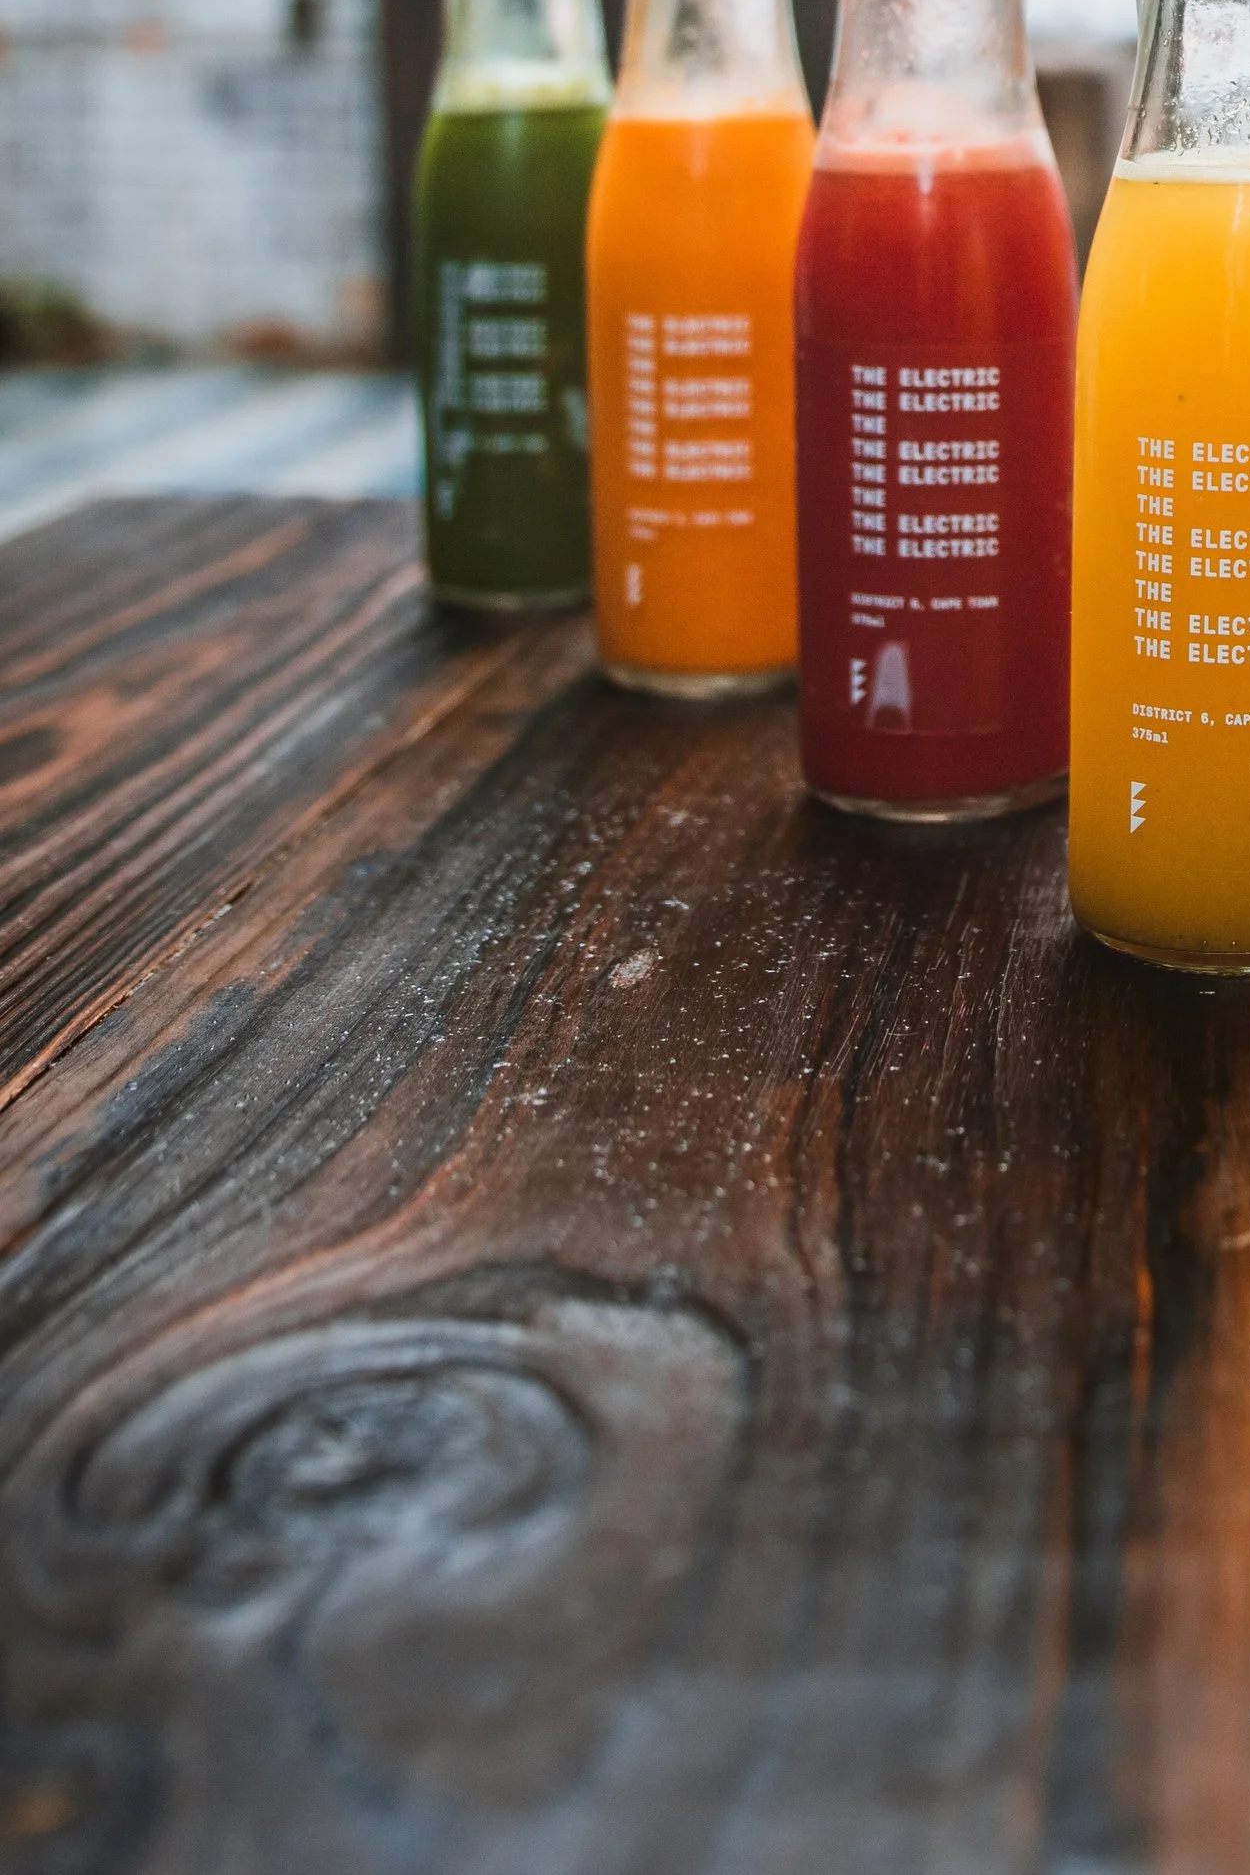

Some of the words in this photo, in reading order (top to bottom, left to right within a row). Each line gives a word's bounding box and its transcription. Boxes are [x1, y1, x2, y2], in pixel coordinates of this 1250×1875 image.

[852, 365, 886, 386] THE
[899, 367, 999, 387] ELECTRIC
[852, 390, 886, 410] THE
[899, 392, 1000, 412] ELECTRIC
[852, 414, 886, 435] THE
[852, 438, 886, 459] THE
[898, 441, 999, 461] ELECTRIC
[1138, 437, 1174, 459] THE
[852, 462, 886, 483] THE
[898, 465, 999, 485] ELECTRIC
[1137, 465, 1174, 488] THE
[852, 486, 886, 508] THE
[1137, 494, 1173, 517] THE
[852, 511, 886, 531] THE
[898, 513, 998, 534] ELECTRIC
[1136, 522, 1173, 545] THE
[852, 535, 886, 556] THE
[898, 538, 999, 558] ELECTRIC
[1136, 550, 1172, 574] THE
[1135, 579, 1172, 602] THE
[1135, 608, 1171, 631] THE
[1134, 636, 1171, 659] THE
[1132, 703, 1192, 723] DISTRICT
[1201, 712, 1215, 726] 6,
[1132, 727, 1168, 744] 375ml
